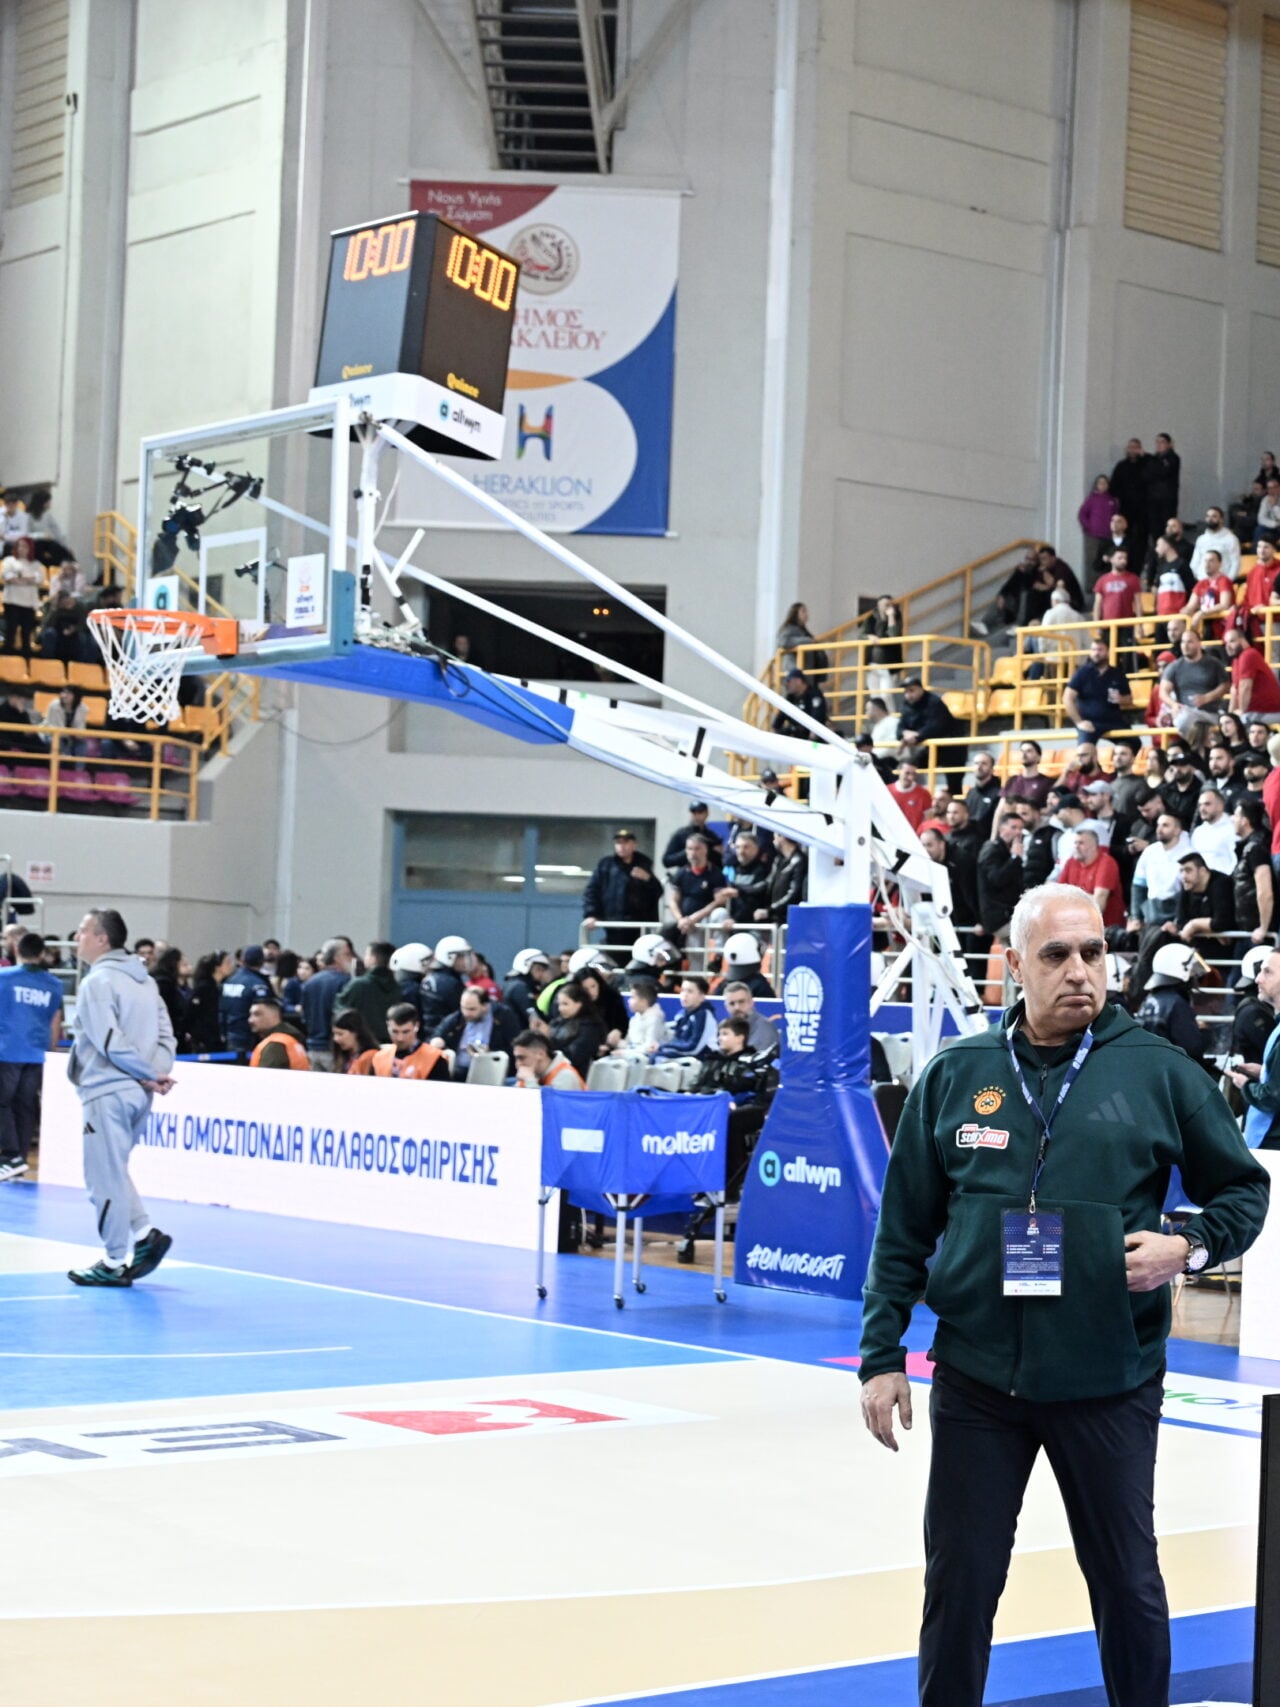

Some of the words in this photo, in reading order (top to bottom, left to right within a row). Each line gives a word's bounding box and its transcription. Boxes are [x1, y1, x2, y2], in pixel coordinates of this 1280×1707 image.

[343, 219, 416, 281] 10:00
[446, 235, 517, 311] 10:00
[514, 307, 583, 329] ΗΜΟΣ
[511, 328, 606, 350] ΚΛΕΙΟΥ
[473, 473, 593, 496] HERAKLION
[13, 986, 51, 1008] TEAM
[183, 1115, 303, 1164] ΟΜΟΣΠΟΝΔΙΑ
[310, 1127, 500, 1187] ΚΑΛΑΘΟΣΦΑΙΡΙΣΗΣ
[641, 1131, 715, 1156] molten
[783, 1156, 841, 1193] allwyn
